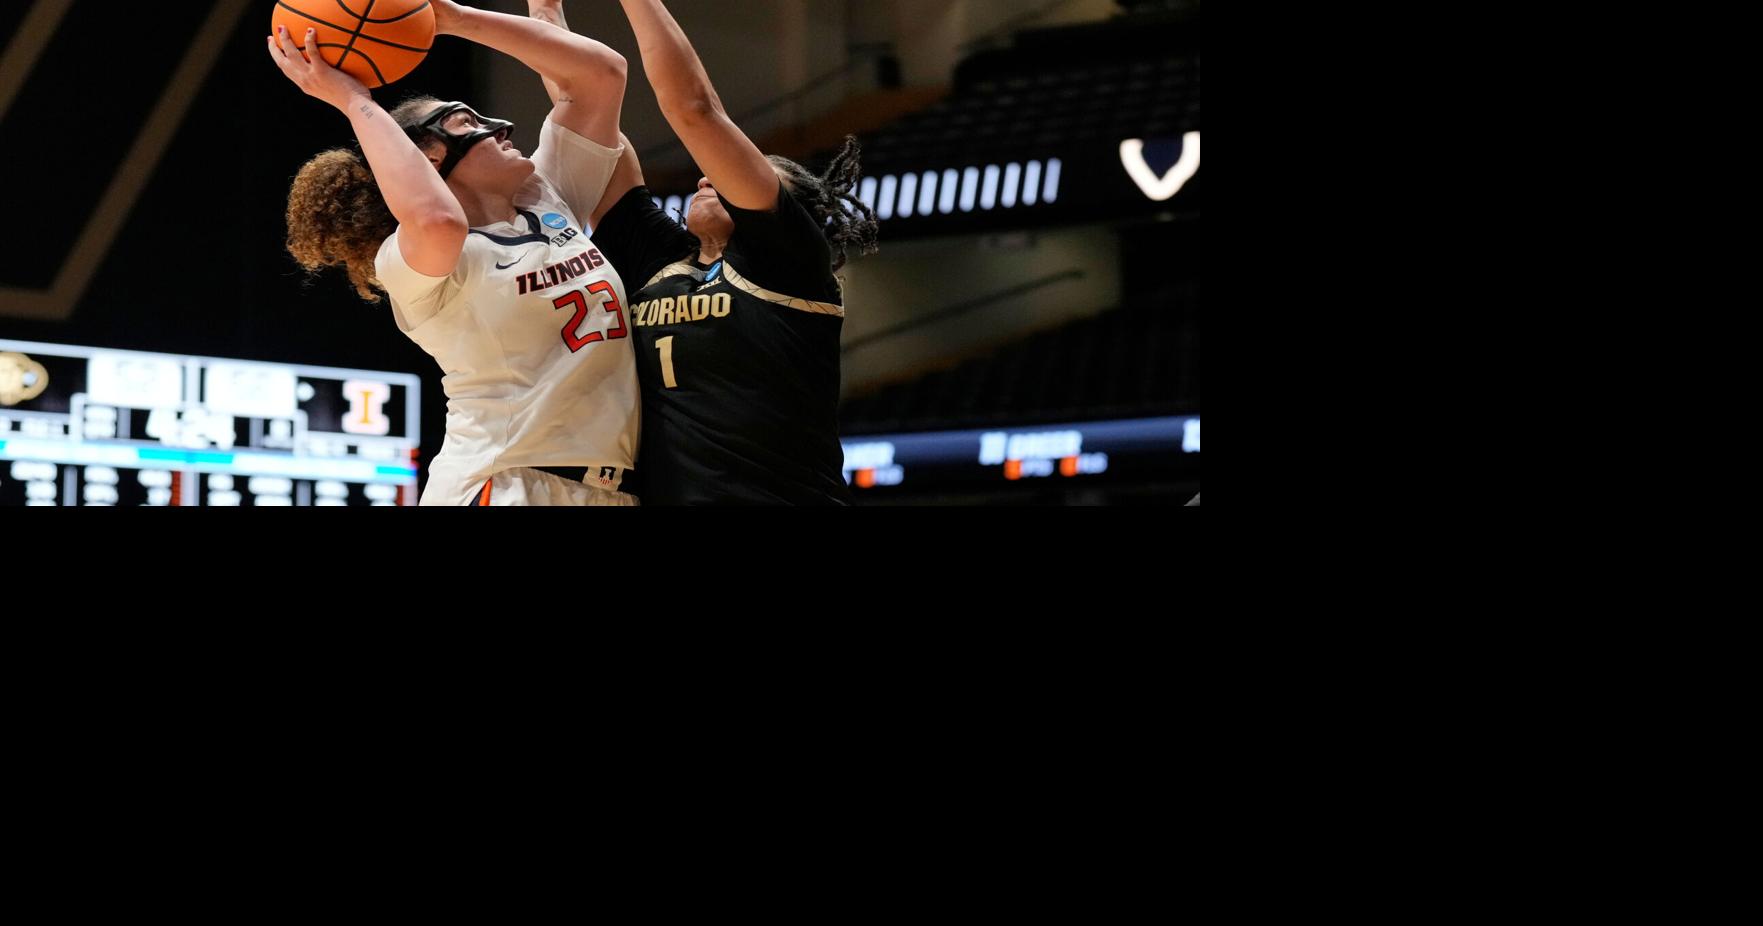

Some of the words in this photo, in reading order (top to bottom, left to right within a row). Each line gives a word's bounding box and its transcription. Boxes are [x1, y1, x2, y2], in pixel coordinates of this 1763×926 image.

[516, 248, 605, 296] ILLINOIS
[552, 279, 628, 353] 23
[655, 335, 678, 388] 1
